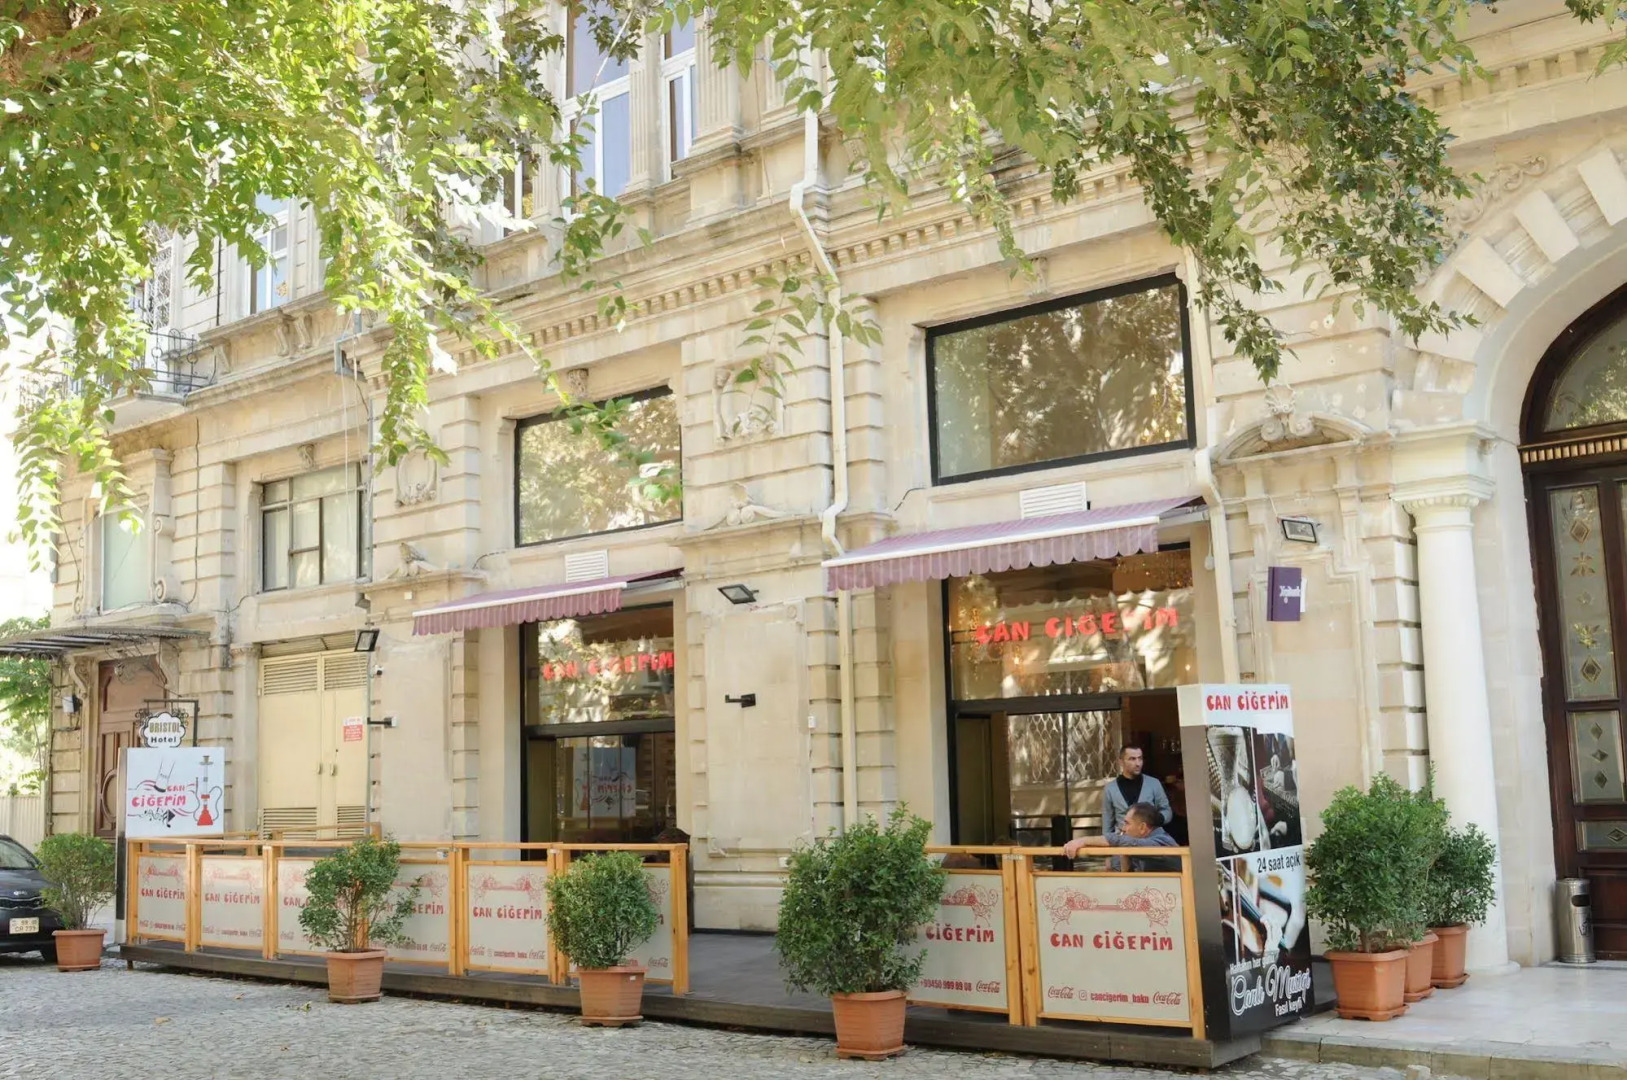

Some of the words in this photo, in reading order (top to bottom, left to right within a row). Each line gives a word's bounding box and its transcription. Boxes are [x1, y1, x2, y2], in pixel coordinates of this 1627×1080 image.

[976, 621, 1031, 644] CAN
[1206, 695, 1231, 711] CAN
[149, 722, 181, 733] BRISTOL
[1257, 857, 1267, 873] 24
[1268, 854, 1285, 872] saat
[141, 888, 154, 897] CAN
[205, 892, 220, 902] CAN
[473, 906, 492, 918] CAN
[1050, 932, 1084, 948] CAN
[1048, 986, 1074, 1000] Coca-Cola
[1153, 991, 1182, 1006] Coca-Cola
